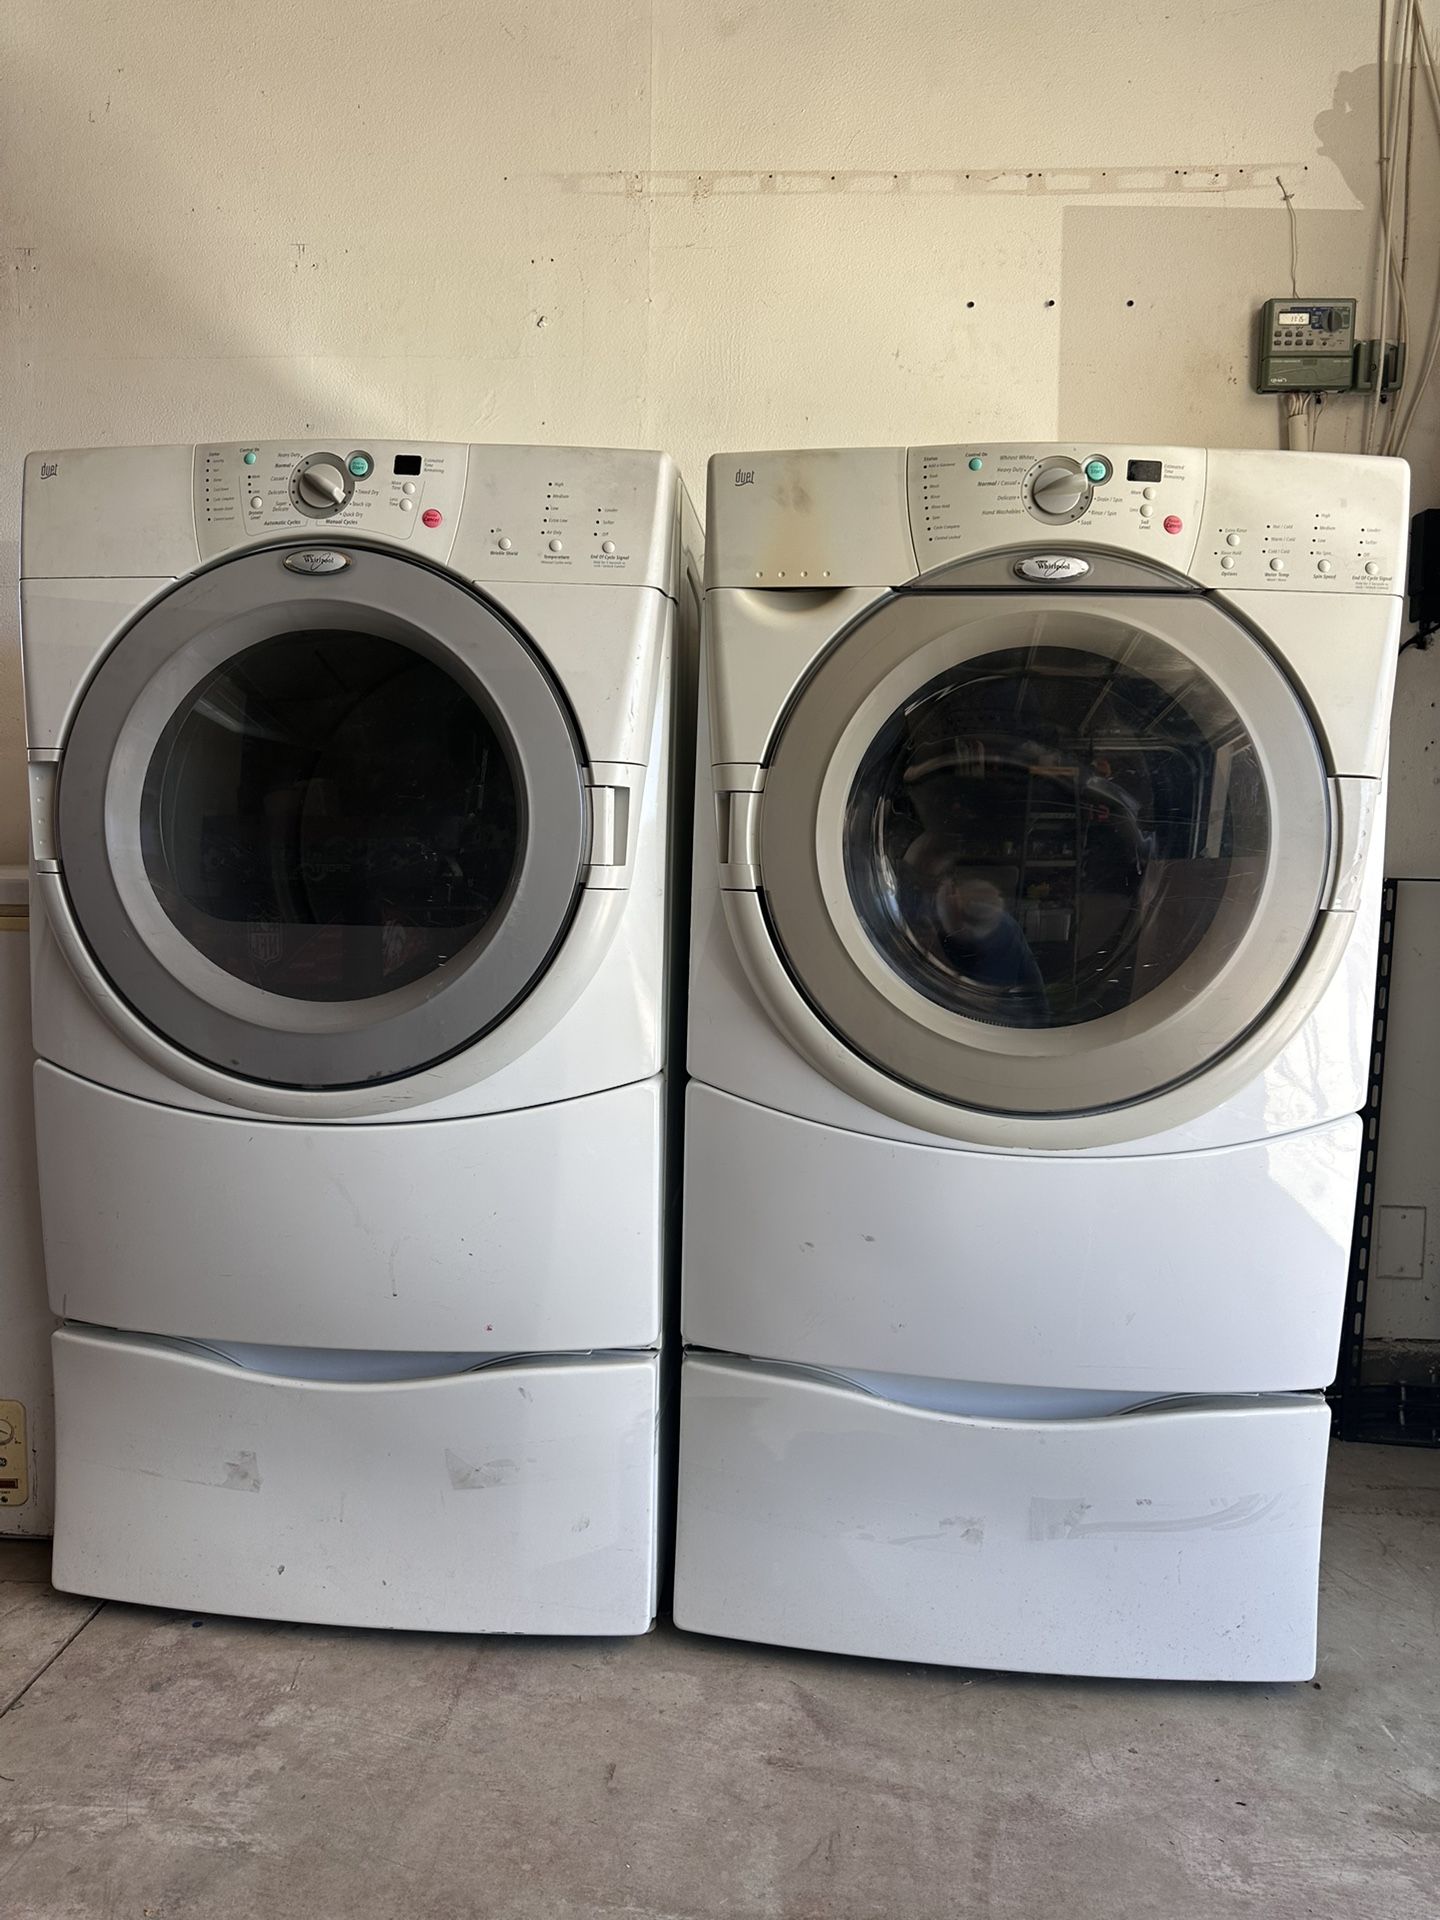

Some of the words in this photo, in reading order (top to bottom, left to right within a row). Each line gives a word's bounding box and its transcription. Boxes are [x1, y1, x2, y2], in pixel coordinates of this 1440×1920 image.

[41, 462, 58, 480] duet
[735, 469, 755, 487] duet
[303, 553, 334, 568] Whirlpool
[1036, 558, 1070, 574] Whirlpool
